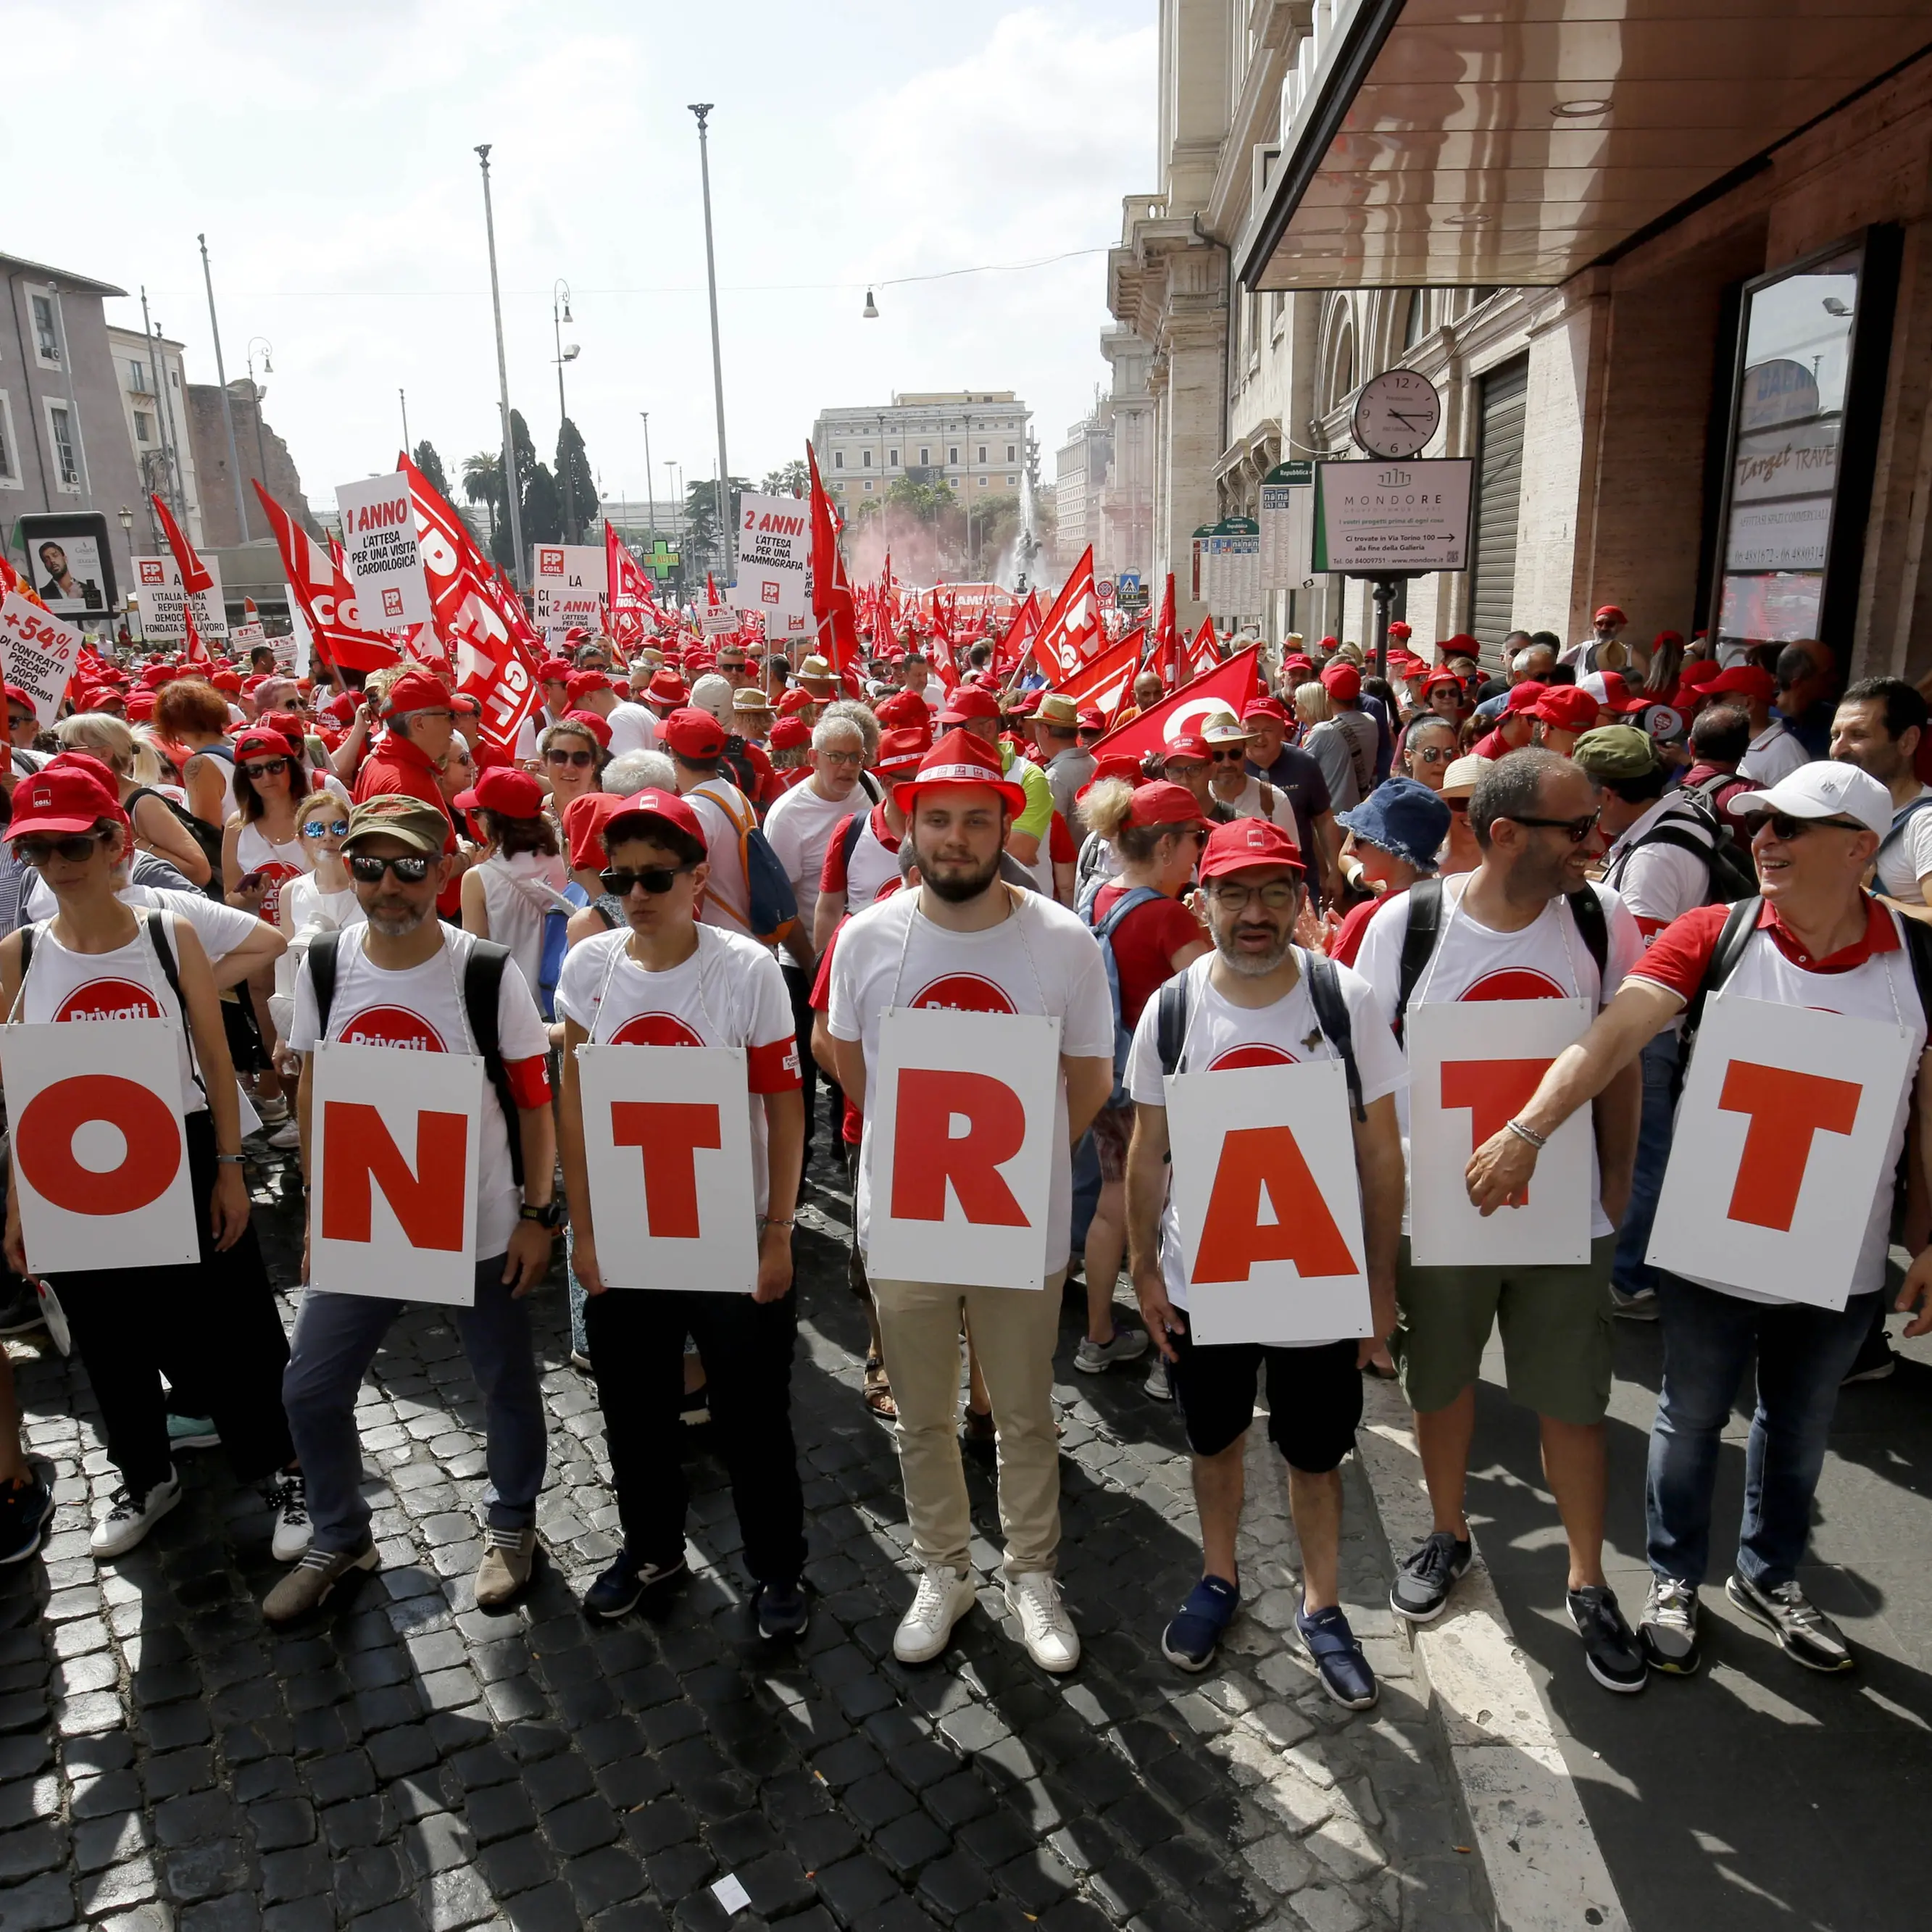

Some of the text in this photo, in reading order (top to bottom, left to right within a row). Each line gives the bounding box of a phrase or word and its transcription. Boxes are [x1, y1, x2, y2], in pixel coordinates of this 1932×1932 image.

[1395, 378, 1410, 388] 12
[1362, 409, 1370, 420] 9
[1425, 410, 1434, 422] 3
[1390, 443, 1399, 454] 6
[1737, 442, 1792, 486] Target
[1344, 494, 1441, 506] MONDORE
[346, 497, 408, 534] 1 ANNO
[744, 510, 804, 537] 2 ANNI
[363, 530, 401, 549] L'ATTESA
[755, 534, 791, 549] L'ATTESA
[351, 541, 417, 565] PER UNA VISITA
[544, 552, 562, 565] FP
[755, 546, 791, 559] PER UNA
[141, 563, 160, 575] FP
[357, 554, 417, 577] CARDIOLOGICA
[741, 553, 804, 572] MAMMOGRAFIA
[569, 575, 583, 587] LA
[763, 583, 778, 596] FP
[151, 592, 183, 601] L'ITALIA
[383, 591, 400, 607] FP
[386, 606, 401, 615] CGIL
[552, 599, 561, 612] 2
[563, 600, 596, 613] ANNI
[707, 608, 728, 617] 87%
[4, 612, 73, 660] +54%
[145, 624, 180, 633] FONDATA
[238, 627, 257, 637] 87%
[268, 638, 289, 648] 12%
[0, 635, 65, 675] DI CONTRATTI
[8, 651, 50, 678] PRECARI
[12, 665, 39, 684] DOPO
[4, 673, 54, 703] PANDEMIA
[70, 1003, 149, 1023] Privati
[16, 1074, 182, 1216] O
[890, 1067, 1032, 1228] R
[1717, 1058, 1863, 1233] T
[322, 1100, 468, 1252] N
[610, 1101, 722, 1238] T
[1190, 1125, 1361, 1284] A
